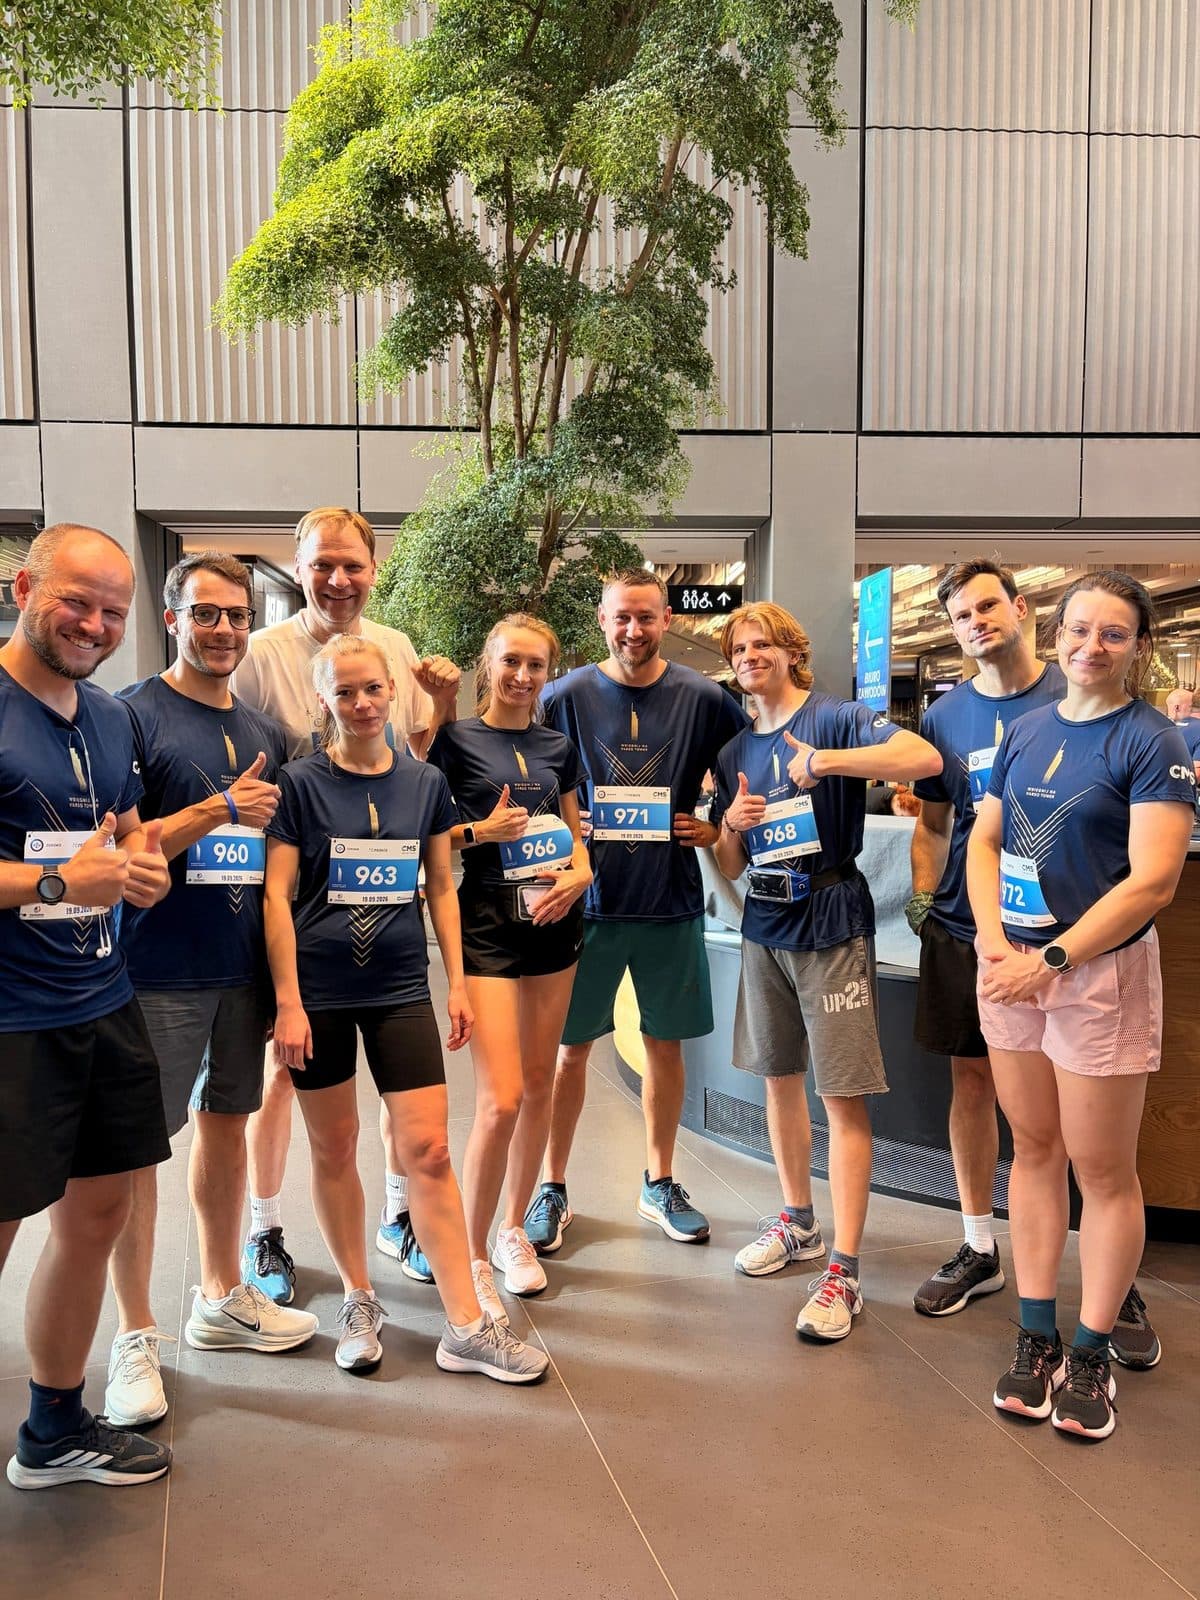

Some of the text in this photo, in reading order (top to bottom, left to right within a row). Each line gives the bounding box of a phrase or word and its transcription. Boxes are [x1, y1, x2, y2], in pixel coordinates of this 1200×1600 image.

[1169, 764, 1196, 786] CMS
[794, 800, 809, 808] CMS
[614, 807, 648, 825] 971
[763, 822, 797, 846] 968
[213, 842, 249, 864] 960
[401, 844, 417, 852] CMS
[521, 837, 557, 860] 966
[355, 865, 398, 885] 963
[822, 981, 861, 1014] UP2
